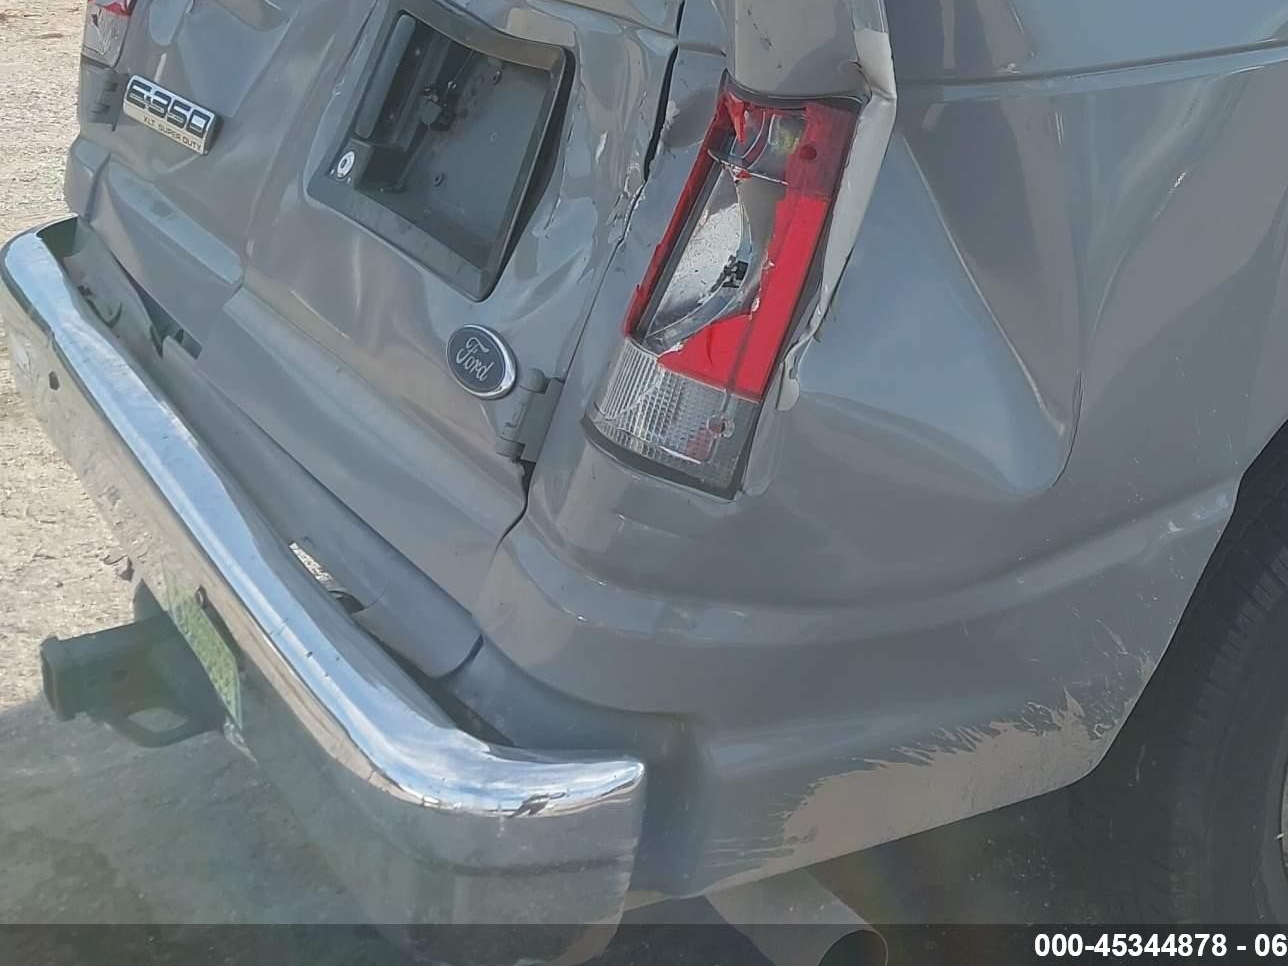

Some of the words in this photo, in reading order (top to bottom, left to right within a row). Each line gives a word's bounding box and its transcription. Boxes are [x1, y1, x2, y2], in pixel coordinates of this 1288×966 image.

[143, 115, 156, 126] XLT
[158, 123, 181, 141] SUPER
[182, 136, 202, 150] DUTY
[456, 336, 495, 382] Ford
